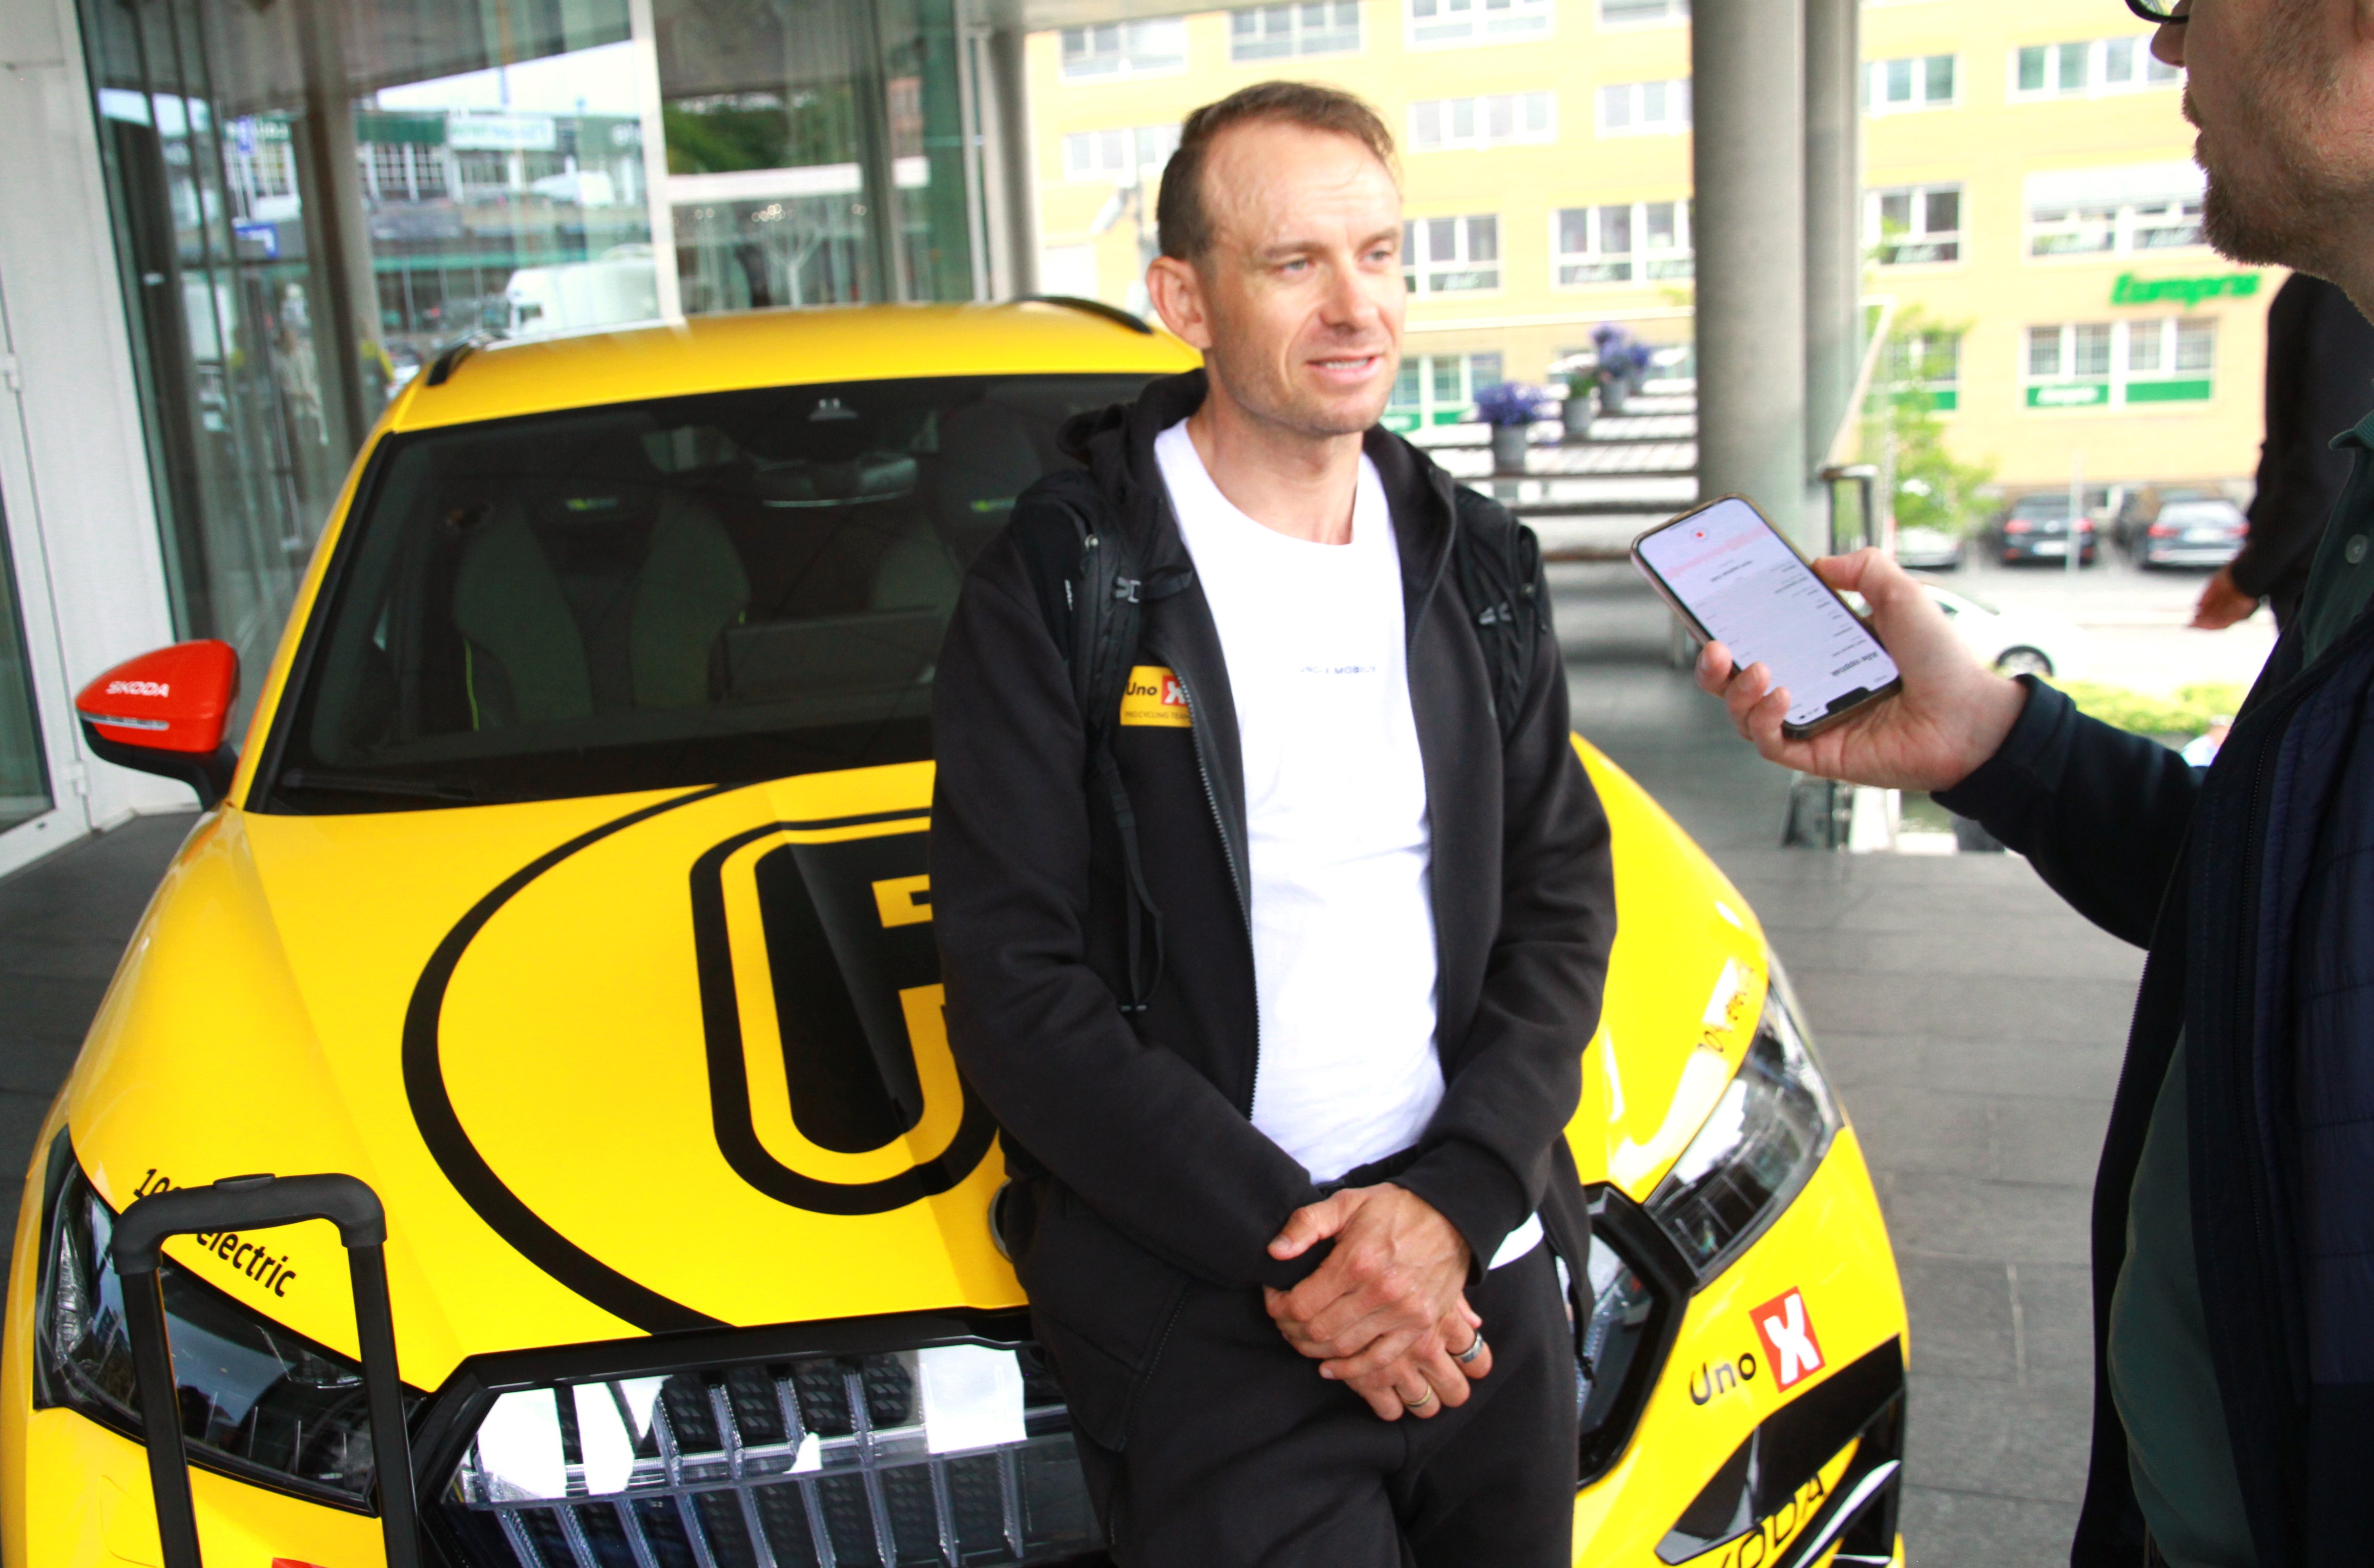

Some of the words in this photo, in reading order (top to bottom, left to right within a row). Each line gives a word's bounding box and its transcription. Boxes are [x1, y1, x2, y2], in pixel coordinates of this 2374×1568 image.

[1125, 681, 1158, 696] Uno
[1164, 680, 1186, 704] X
[133, 1169, 184, 1198] 10
[1689, 1352, 1756, 1406] Uno
[1763, 1293, 1821, 1385] X
